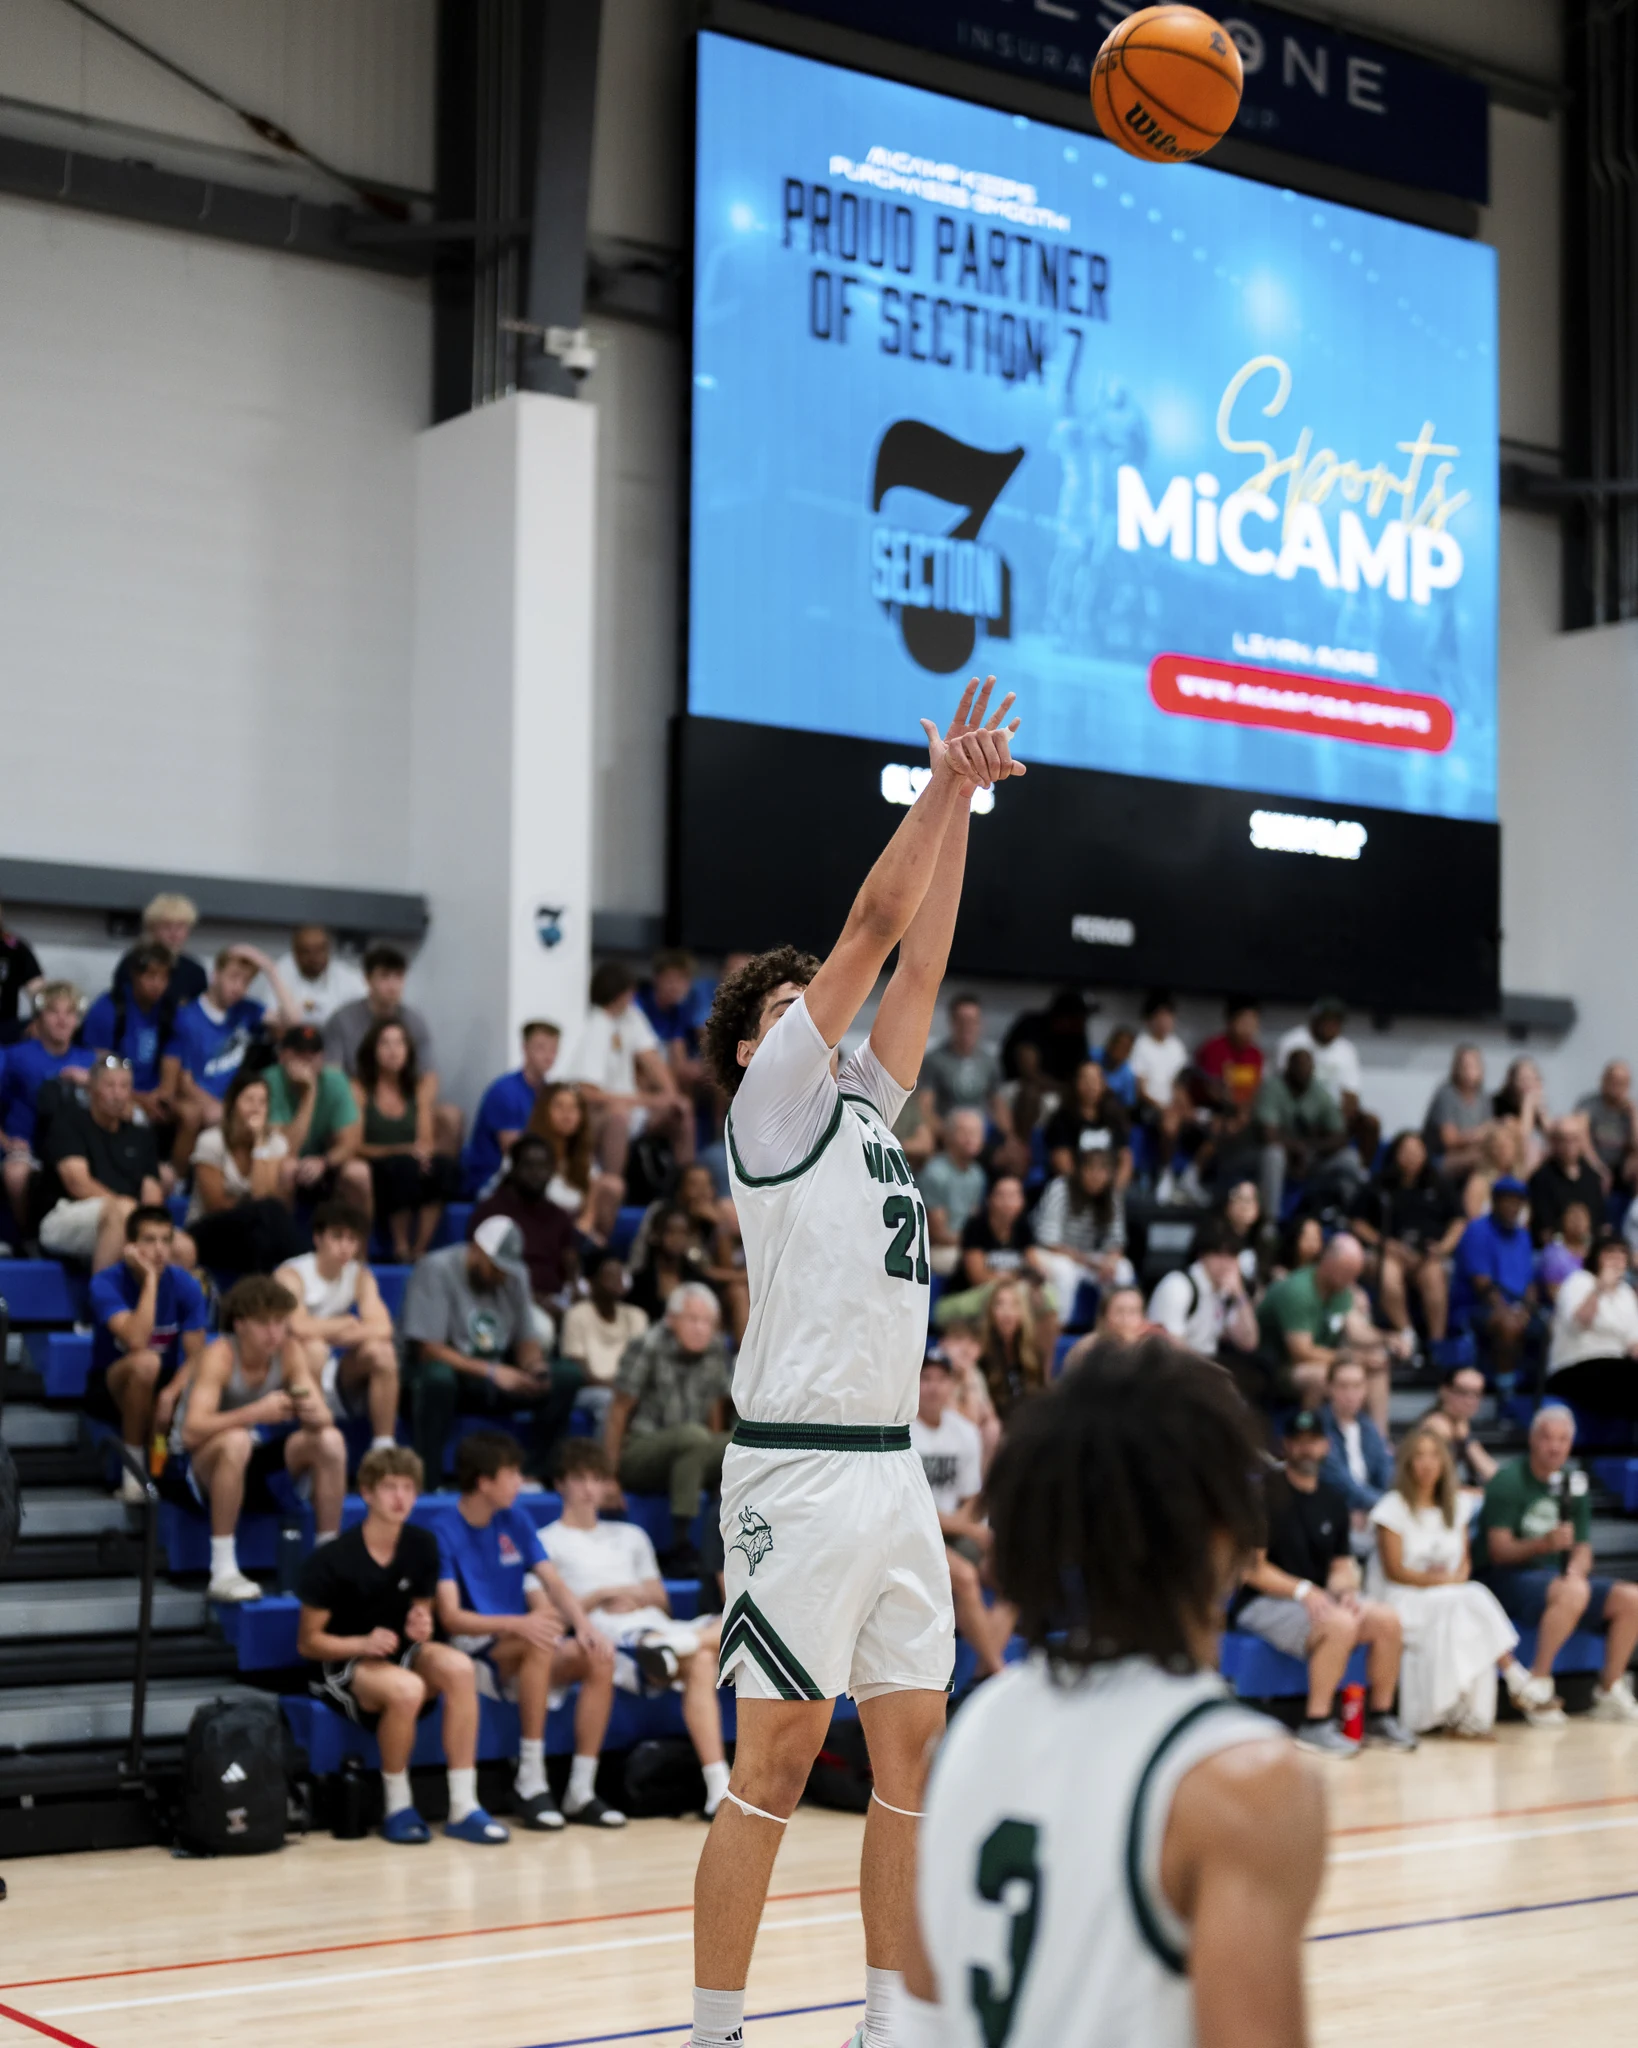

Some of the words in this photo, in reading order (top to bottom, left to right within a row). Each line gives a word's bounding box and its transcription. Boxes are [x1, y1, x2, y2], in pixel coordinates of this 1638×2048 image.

[783, 175, 912, 275] PROUD
[936, 214, 1109, 321] PARTNER
[809, 268, 861, 344] OF
[880, 285, 1045, 386] SECTION
[1063, 325, 1084, 414] 7
[870, 527, 1001, 621] SECTION
[1116, 464, 1464, 606] MiCAMP
[883, 1195, 930, 1286] 21
